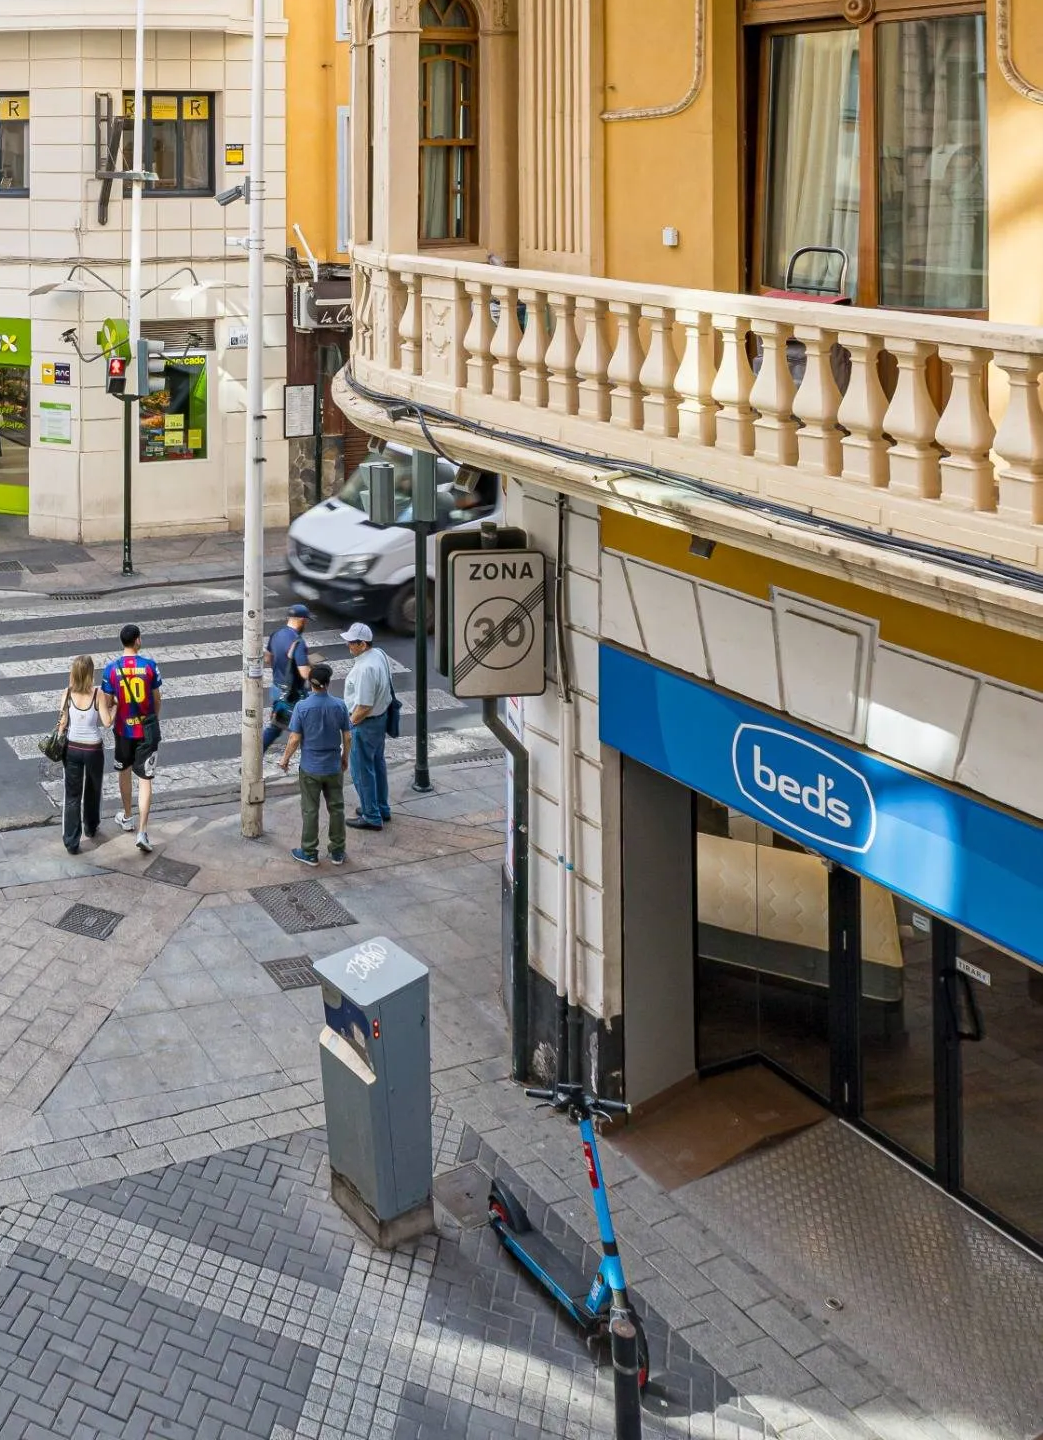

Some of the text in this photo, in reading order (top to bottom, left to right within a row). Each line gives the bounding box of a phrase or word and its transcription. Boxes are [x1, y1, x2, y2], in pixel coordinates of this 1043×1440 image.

[469, 562, 534, 582] ZONA
[473, 616, 526, 648] 30
[119, 676, 146, 704] 10
